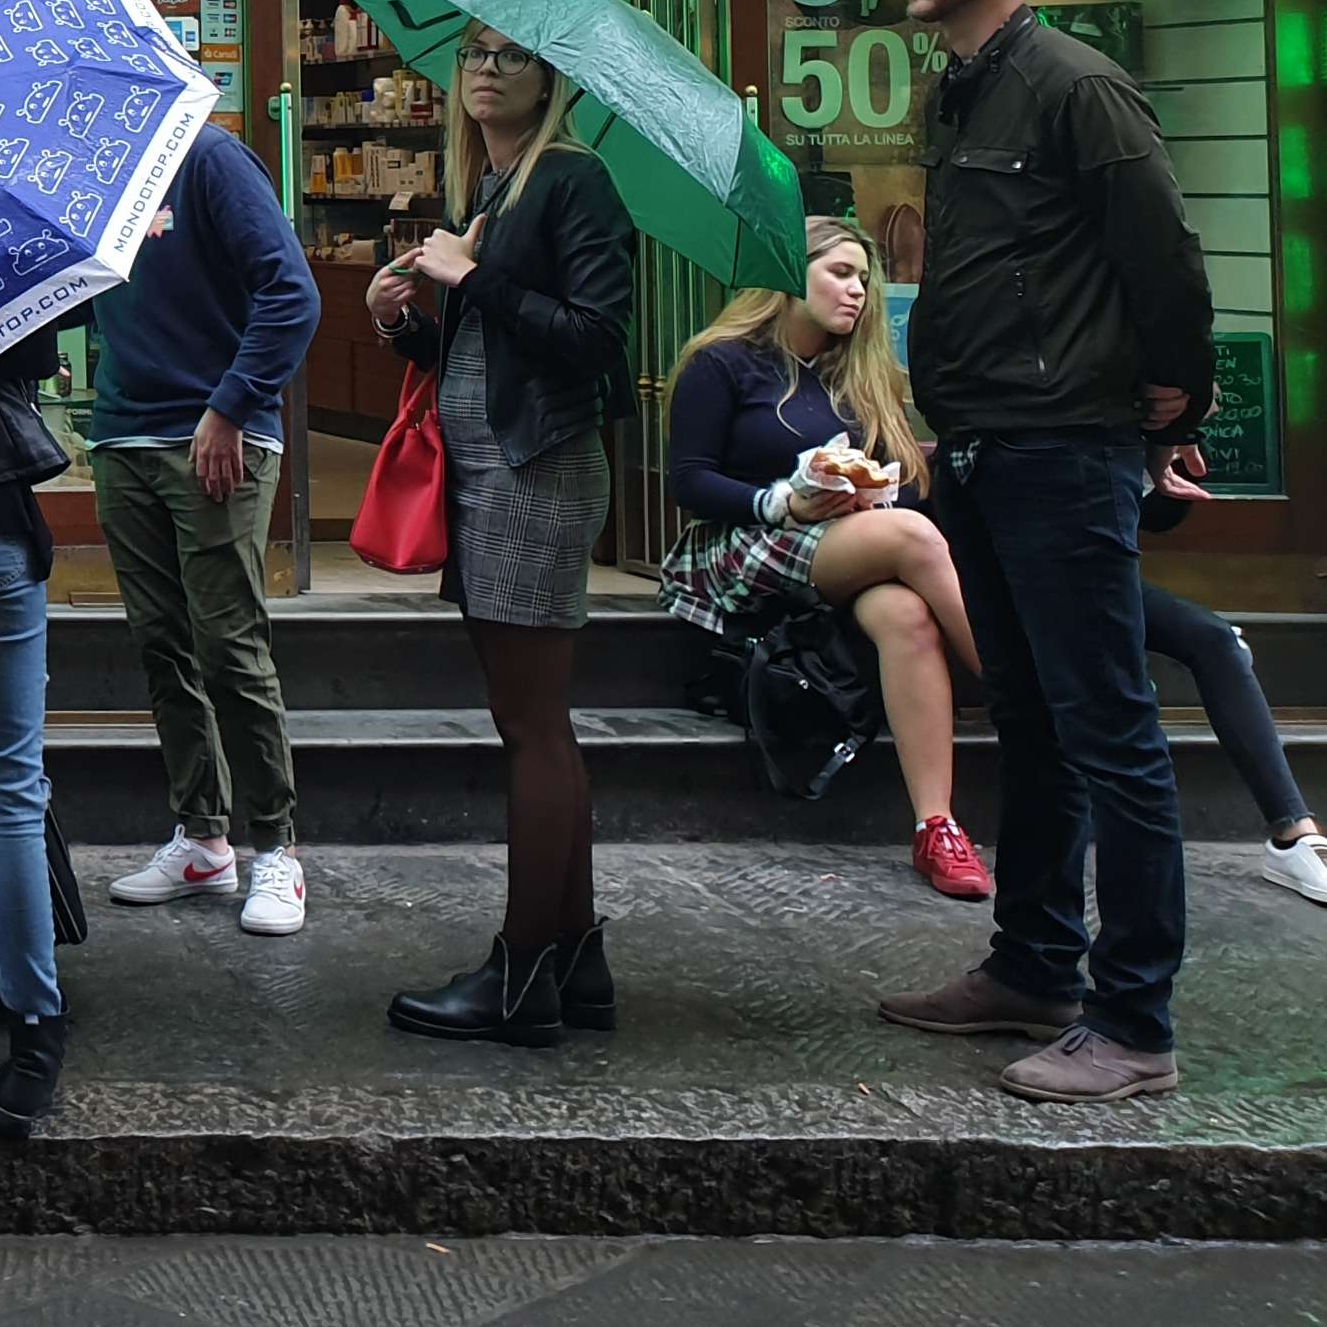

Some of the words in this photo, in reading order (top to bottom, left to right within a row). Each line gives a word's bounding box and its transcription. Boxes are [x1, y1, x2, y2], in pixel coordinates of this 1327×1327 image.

[785, 16, 840, 27] SCONTO
[782, 29, 948, 129] 50%
[786, 134, 805, 146] SU
[808, 134, 850, 146] TUTTA
[853, 134, 871, 146] LA
[874, 133, 915, 146] LINEA
[114, 113, 194, 253] MONDOTOP.COM
